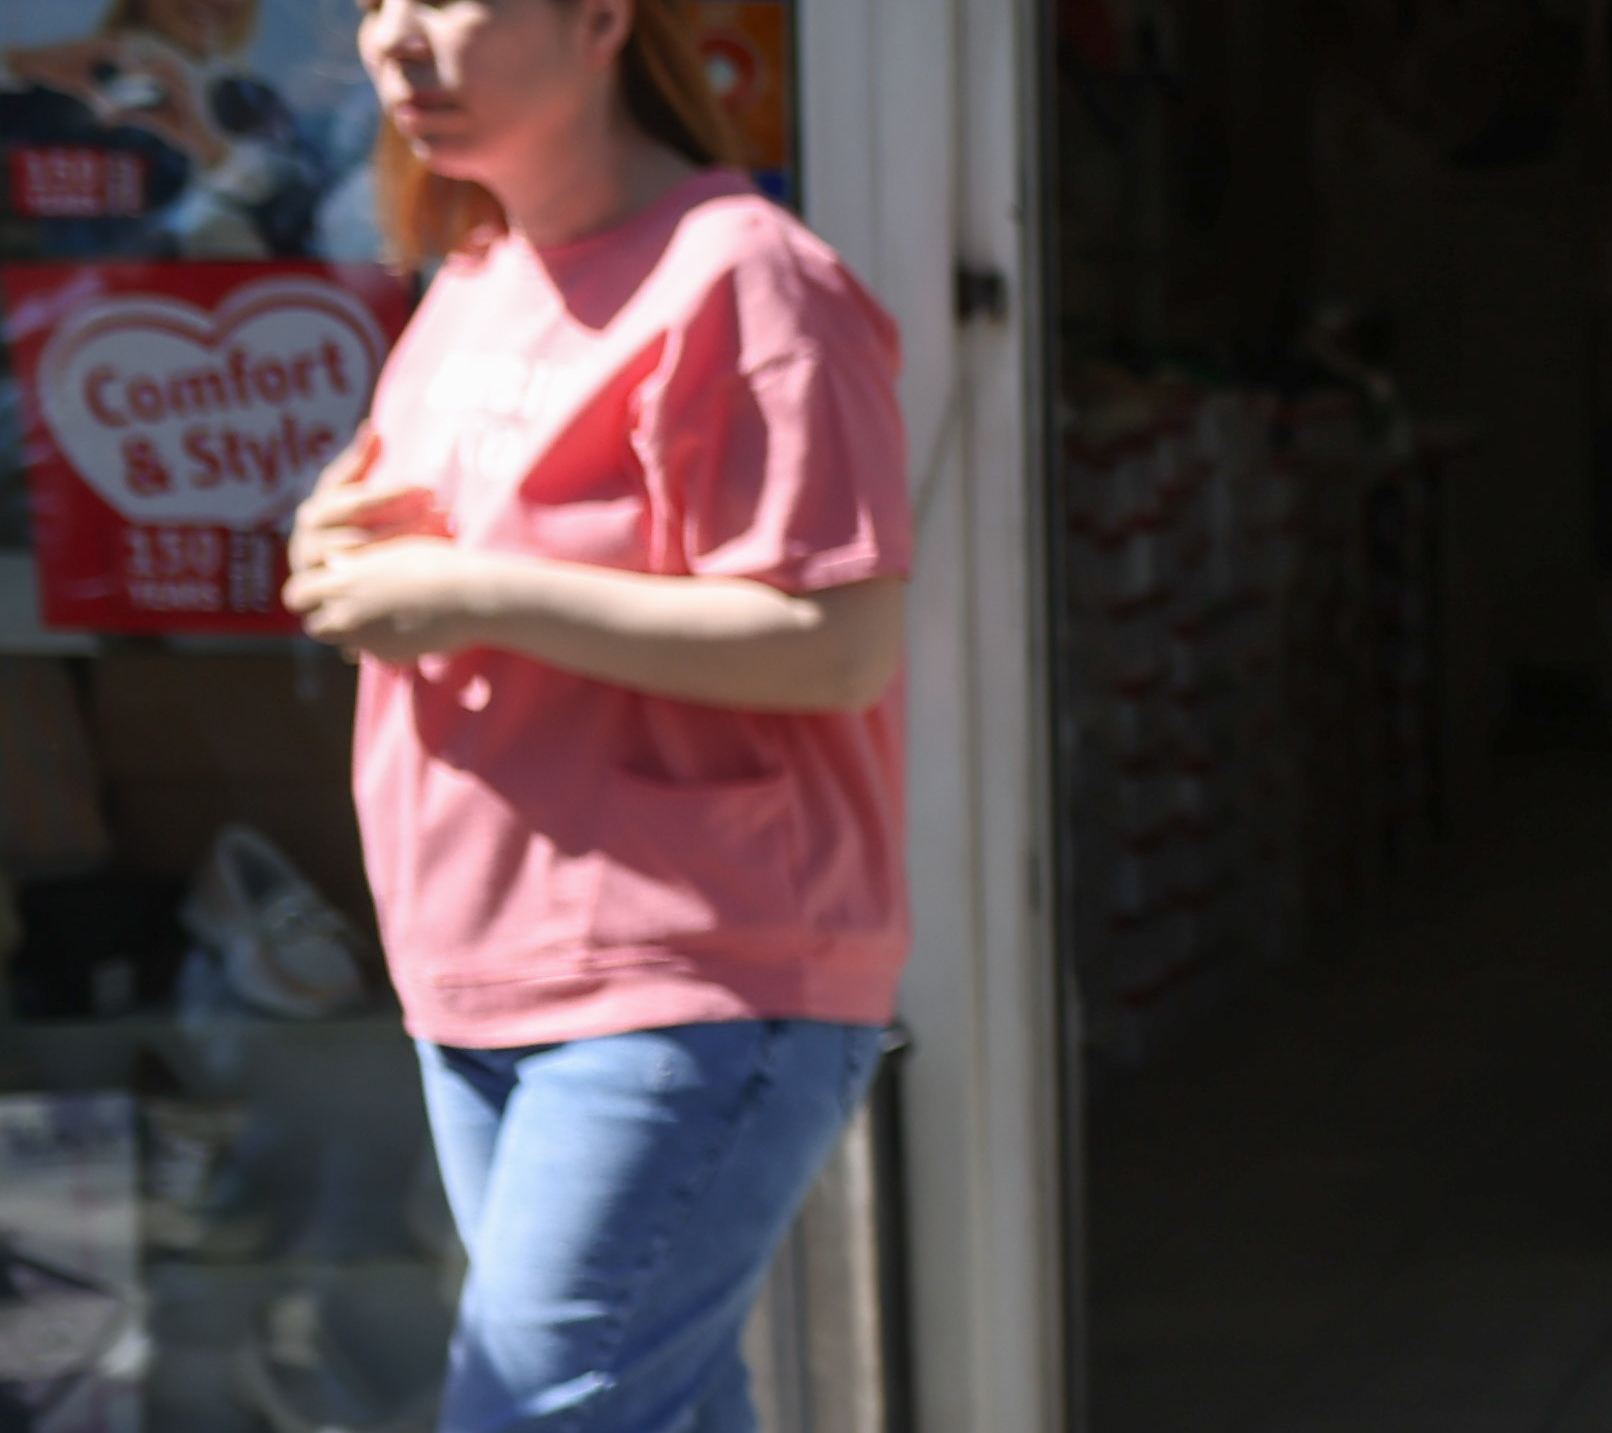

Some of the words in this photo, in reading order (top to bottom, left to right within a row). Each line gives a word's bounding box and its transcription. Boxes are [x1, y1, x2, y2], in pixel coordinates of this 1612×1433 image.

[84, 337, 348, 426] Comfort
[120, 435, 173, 497] &
[181, 408, 336, 494] Style
